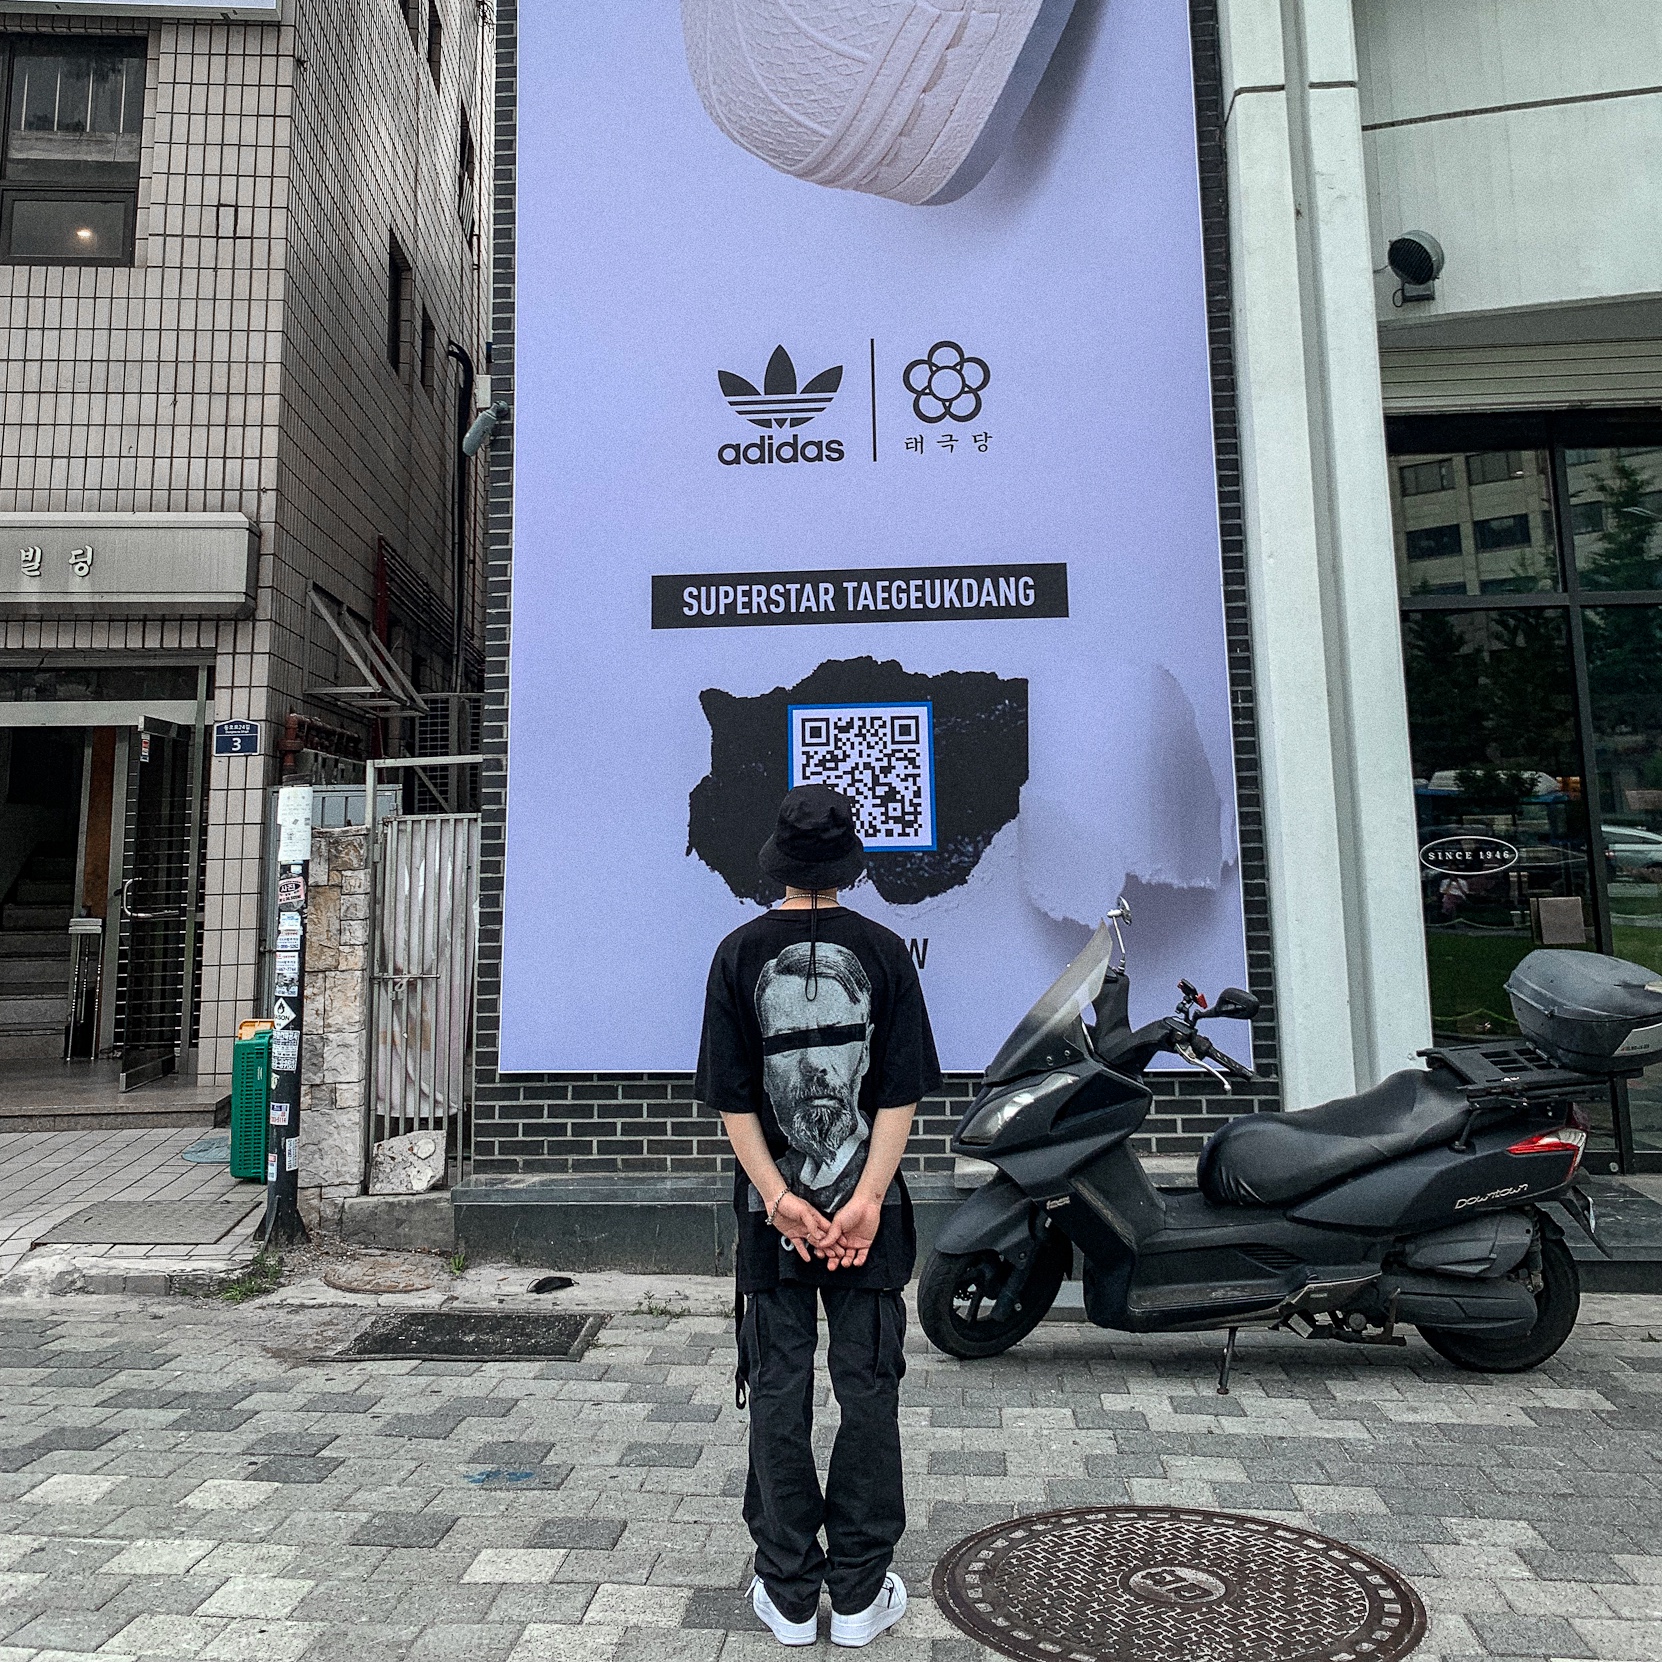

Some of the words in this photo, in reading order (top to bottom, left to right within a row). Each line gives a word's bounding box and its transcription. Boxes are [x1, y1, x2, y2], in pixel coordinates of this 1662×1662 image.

[717, 434, 845, 466] adidas
[904, 431, 993, 455] 태극당
[682, 582, 836, 616] SUPERSTAR
[842, 576, 1036, 612] TAEGEUKDANG
[231, 737, 242, 752] 3
[1428, 851, 1472, 860] SINCE
[1479, 850, 1509, 860] 1946
